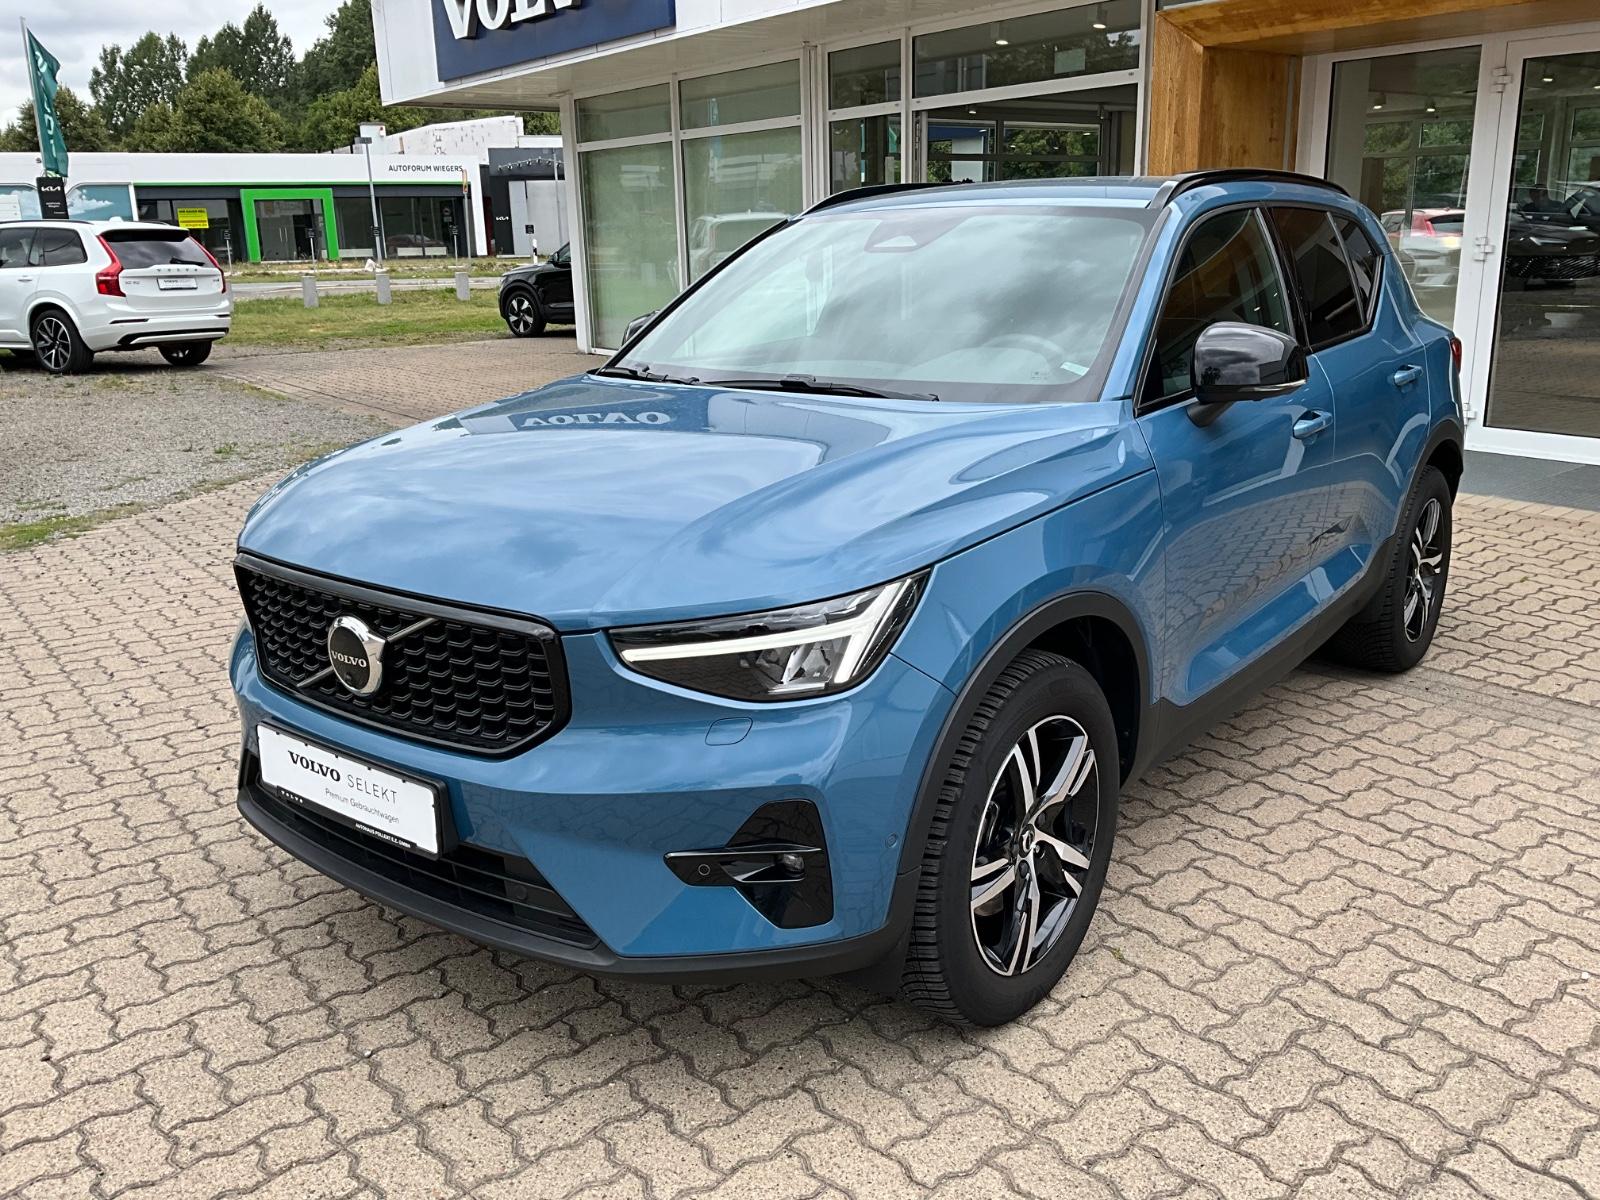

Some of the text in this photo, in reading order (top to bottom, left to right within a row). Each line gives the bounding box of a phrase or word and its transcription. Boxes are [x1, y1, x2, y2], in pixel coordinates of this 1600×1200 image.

[388, 164, 463, 172] AUTOFORUM WIEGERS
[331, 651, 367, 667] VOLVO
[288, 750, 398, 804] VOLVO SELEKT
[325, 787, 400, 824] Premium Gebrauchtwagen
